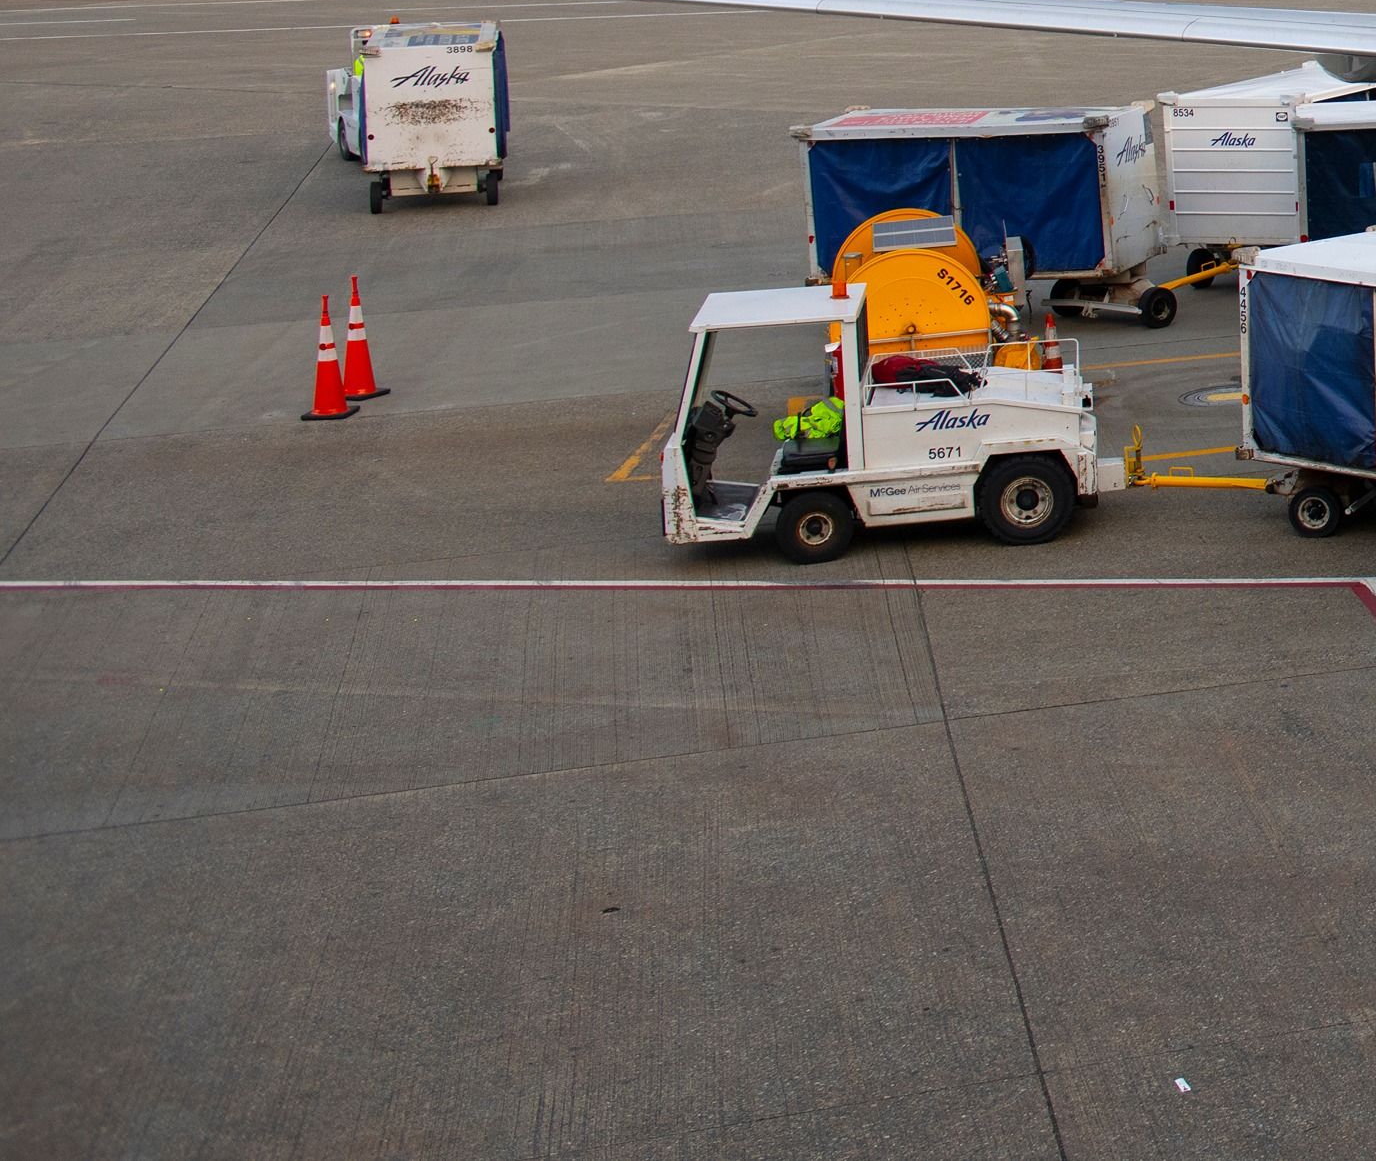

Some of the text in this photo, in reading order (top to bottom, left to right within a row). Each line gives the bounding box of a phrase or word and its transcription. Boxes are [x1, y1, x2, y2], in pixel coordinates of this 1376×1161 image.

[446, 45, 473, 54] 3898
[390, 65, 470, 88] Alaska
[1173, 108, 1194, 117] 8534
[1210, 131, 1256, 149] Alaska
[1116, 134, 1147, 167] Alaska
[936, 268, 975, 306] S1716
[915, 408, 991, 433] Alaska
[928, 446, 961, 460] 5671
[869, 487, 907, 498] McGee
